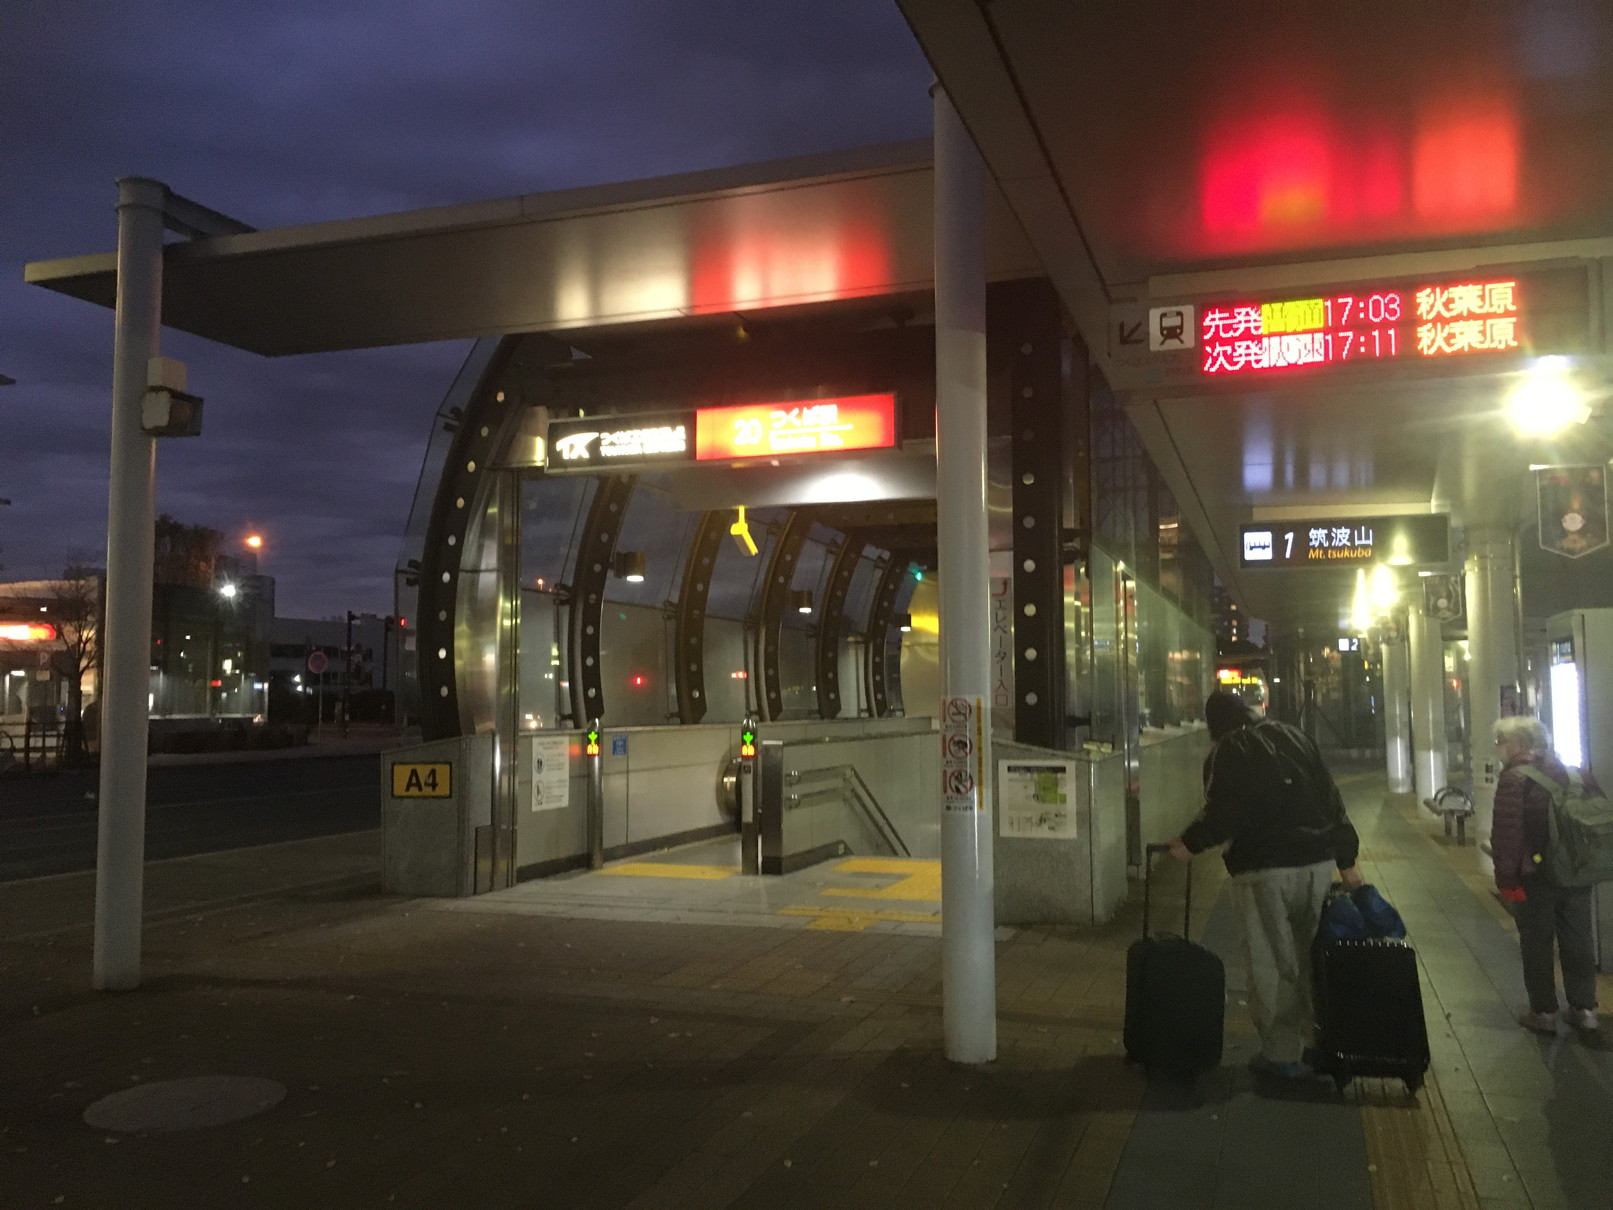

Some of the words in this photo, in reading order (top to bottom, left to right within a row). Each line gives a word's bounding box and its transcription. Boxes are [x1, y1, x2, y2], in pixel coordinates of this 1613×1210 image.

[1203, 306, 1262, 339] 先発
[1324, 293, 1401, 326] 17:03
[1416, 281, 1517, 320] 秋葉原
[1204, 340, 1263, 372] 次発
[1325, 328, 1397, 360] 17:11
[1417, 317, 1519, 355] 秋葉原
[734, 418, 763, 446] 20
[1284, 531, 1294, 559] 1
[1308, 525, 1373, 548] 筑波山
[993, 600, 1009, 707] エレベーター入口
[1351, 638, 1358, 651] 2
[404, 768, 439, 792] A4
